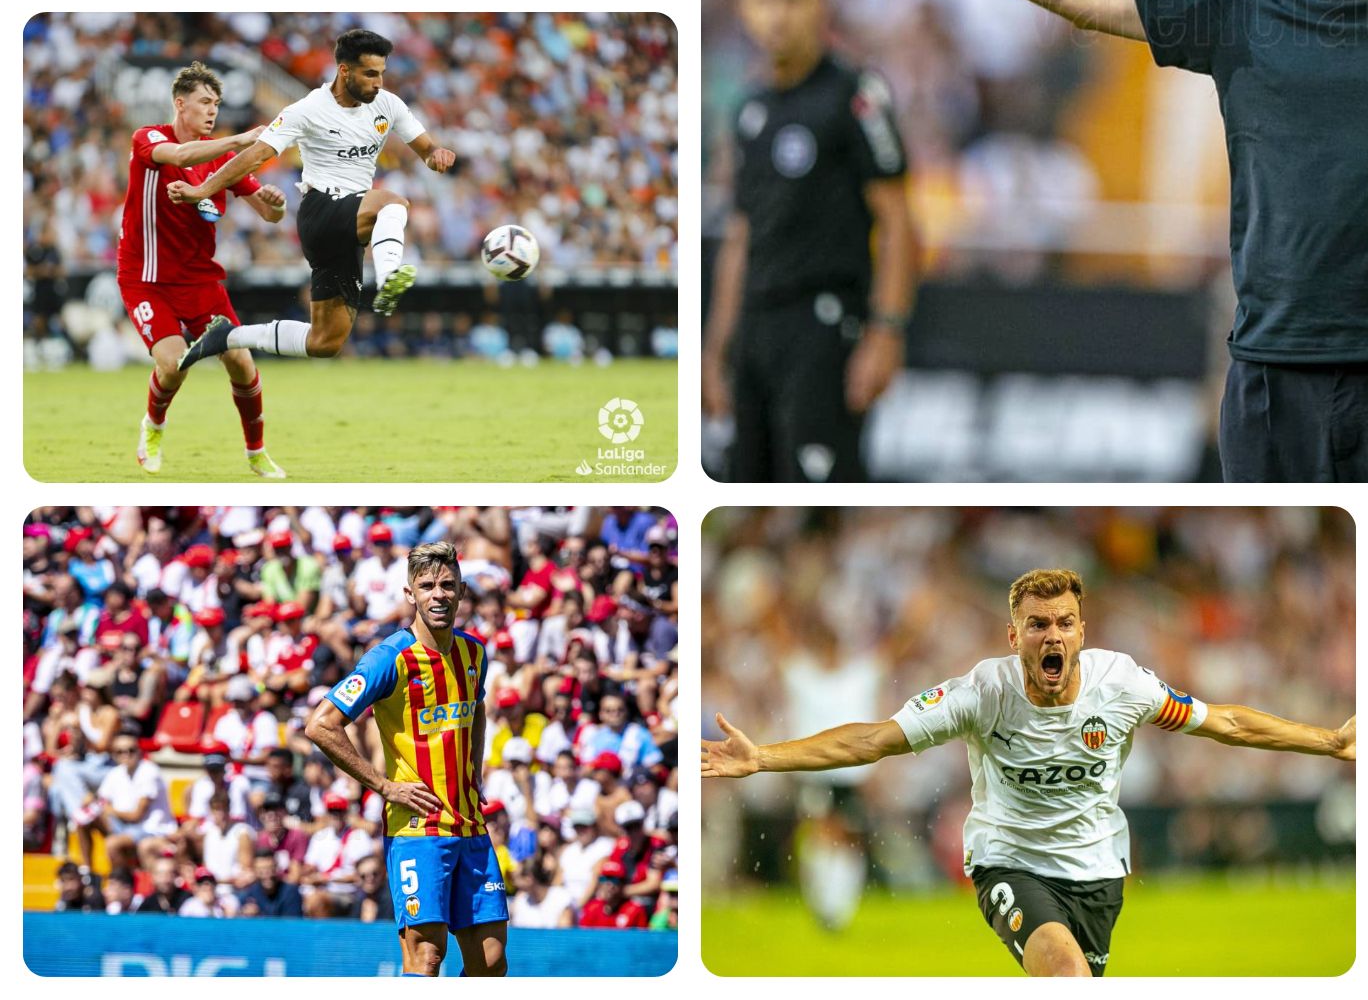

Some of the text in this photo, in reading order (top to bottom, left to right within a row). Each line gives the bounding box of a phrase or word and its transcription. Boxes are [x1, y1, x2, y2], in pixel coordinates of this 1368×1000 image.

[133, 301, 154, 326] 18
[1001, 760, 1107, 785] CAZOO
[400, 859, 420, 896] 5
